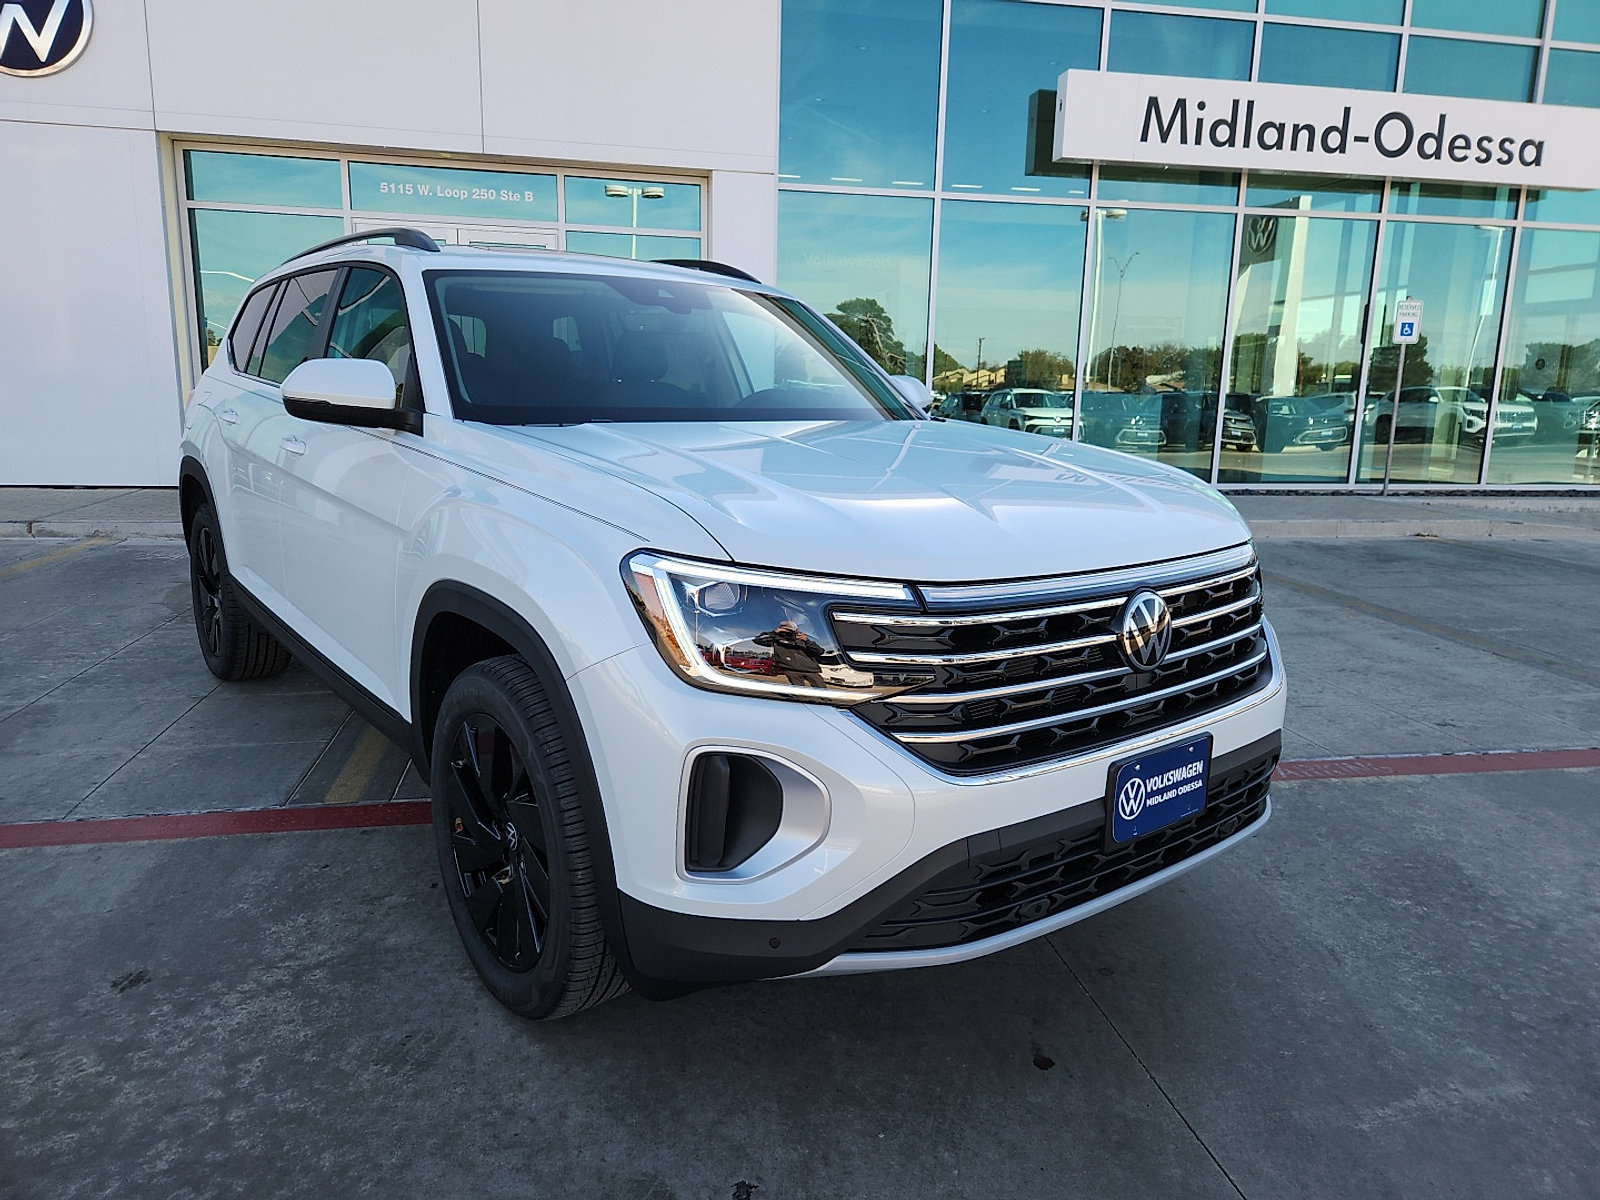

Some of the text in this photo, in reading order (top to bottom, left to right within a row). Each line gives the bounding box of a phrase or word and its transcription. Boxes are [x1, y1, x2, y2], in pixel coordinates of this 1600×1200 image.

[1140, 95, 1545, 167] Midland-Odessa
[380, 182, 534, 202] 5115 W. Loop 250 Ste B
[1125, 592, 1171, 671] VW
[1146, 760, 1204, 793] VOLKSWAGEN
[1146, 779, 1203, 807] MIDLAND ODESSA
[1118, 778, 1145, 820] VW
